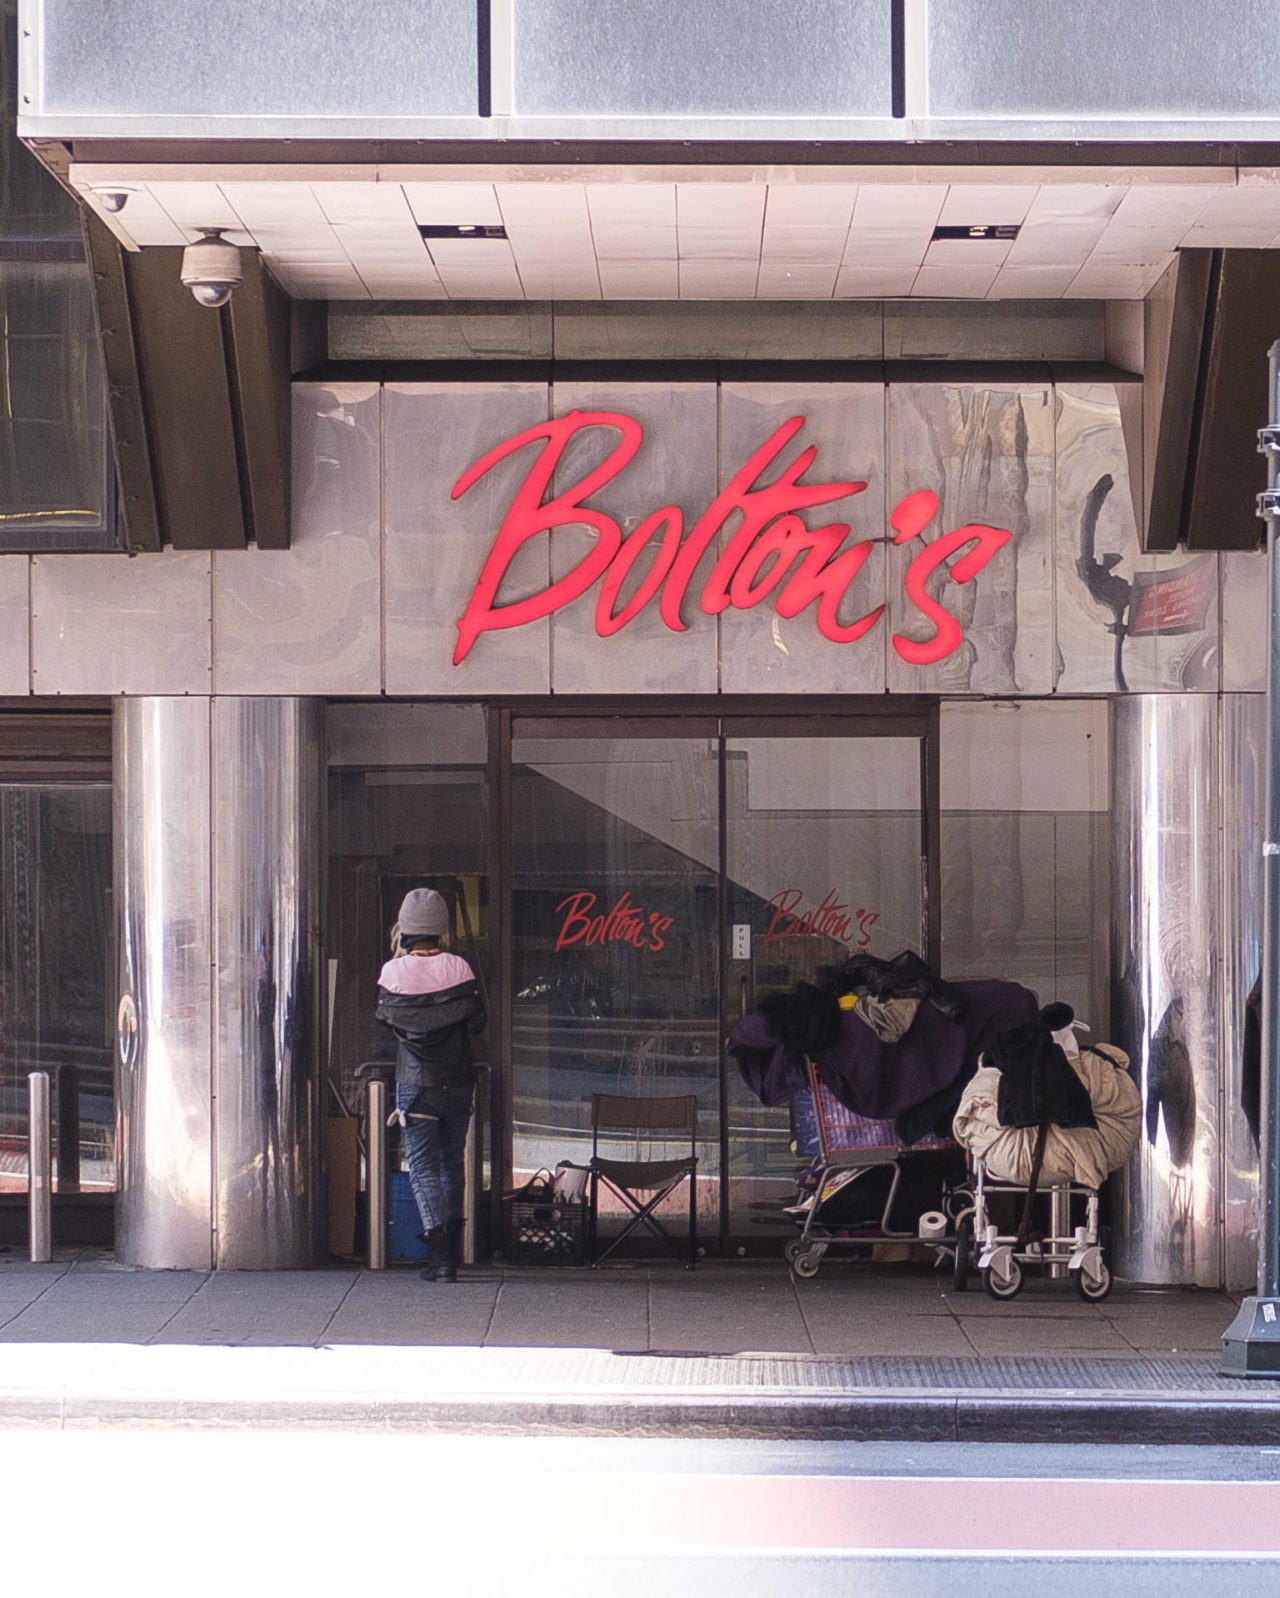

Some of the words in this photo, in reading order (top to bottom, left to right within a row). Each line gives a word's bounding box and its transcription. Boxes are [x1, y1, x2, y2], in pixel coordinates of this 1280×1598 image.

[451, 409, 1012, 665] Bolton's
[555, 892, 674, 952] Bolton's
[764, 887, 880, 947] Bolton's
